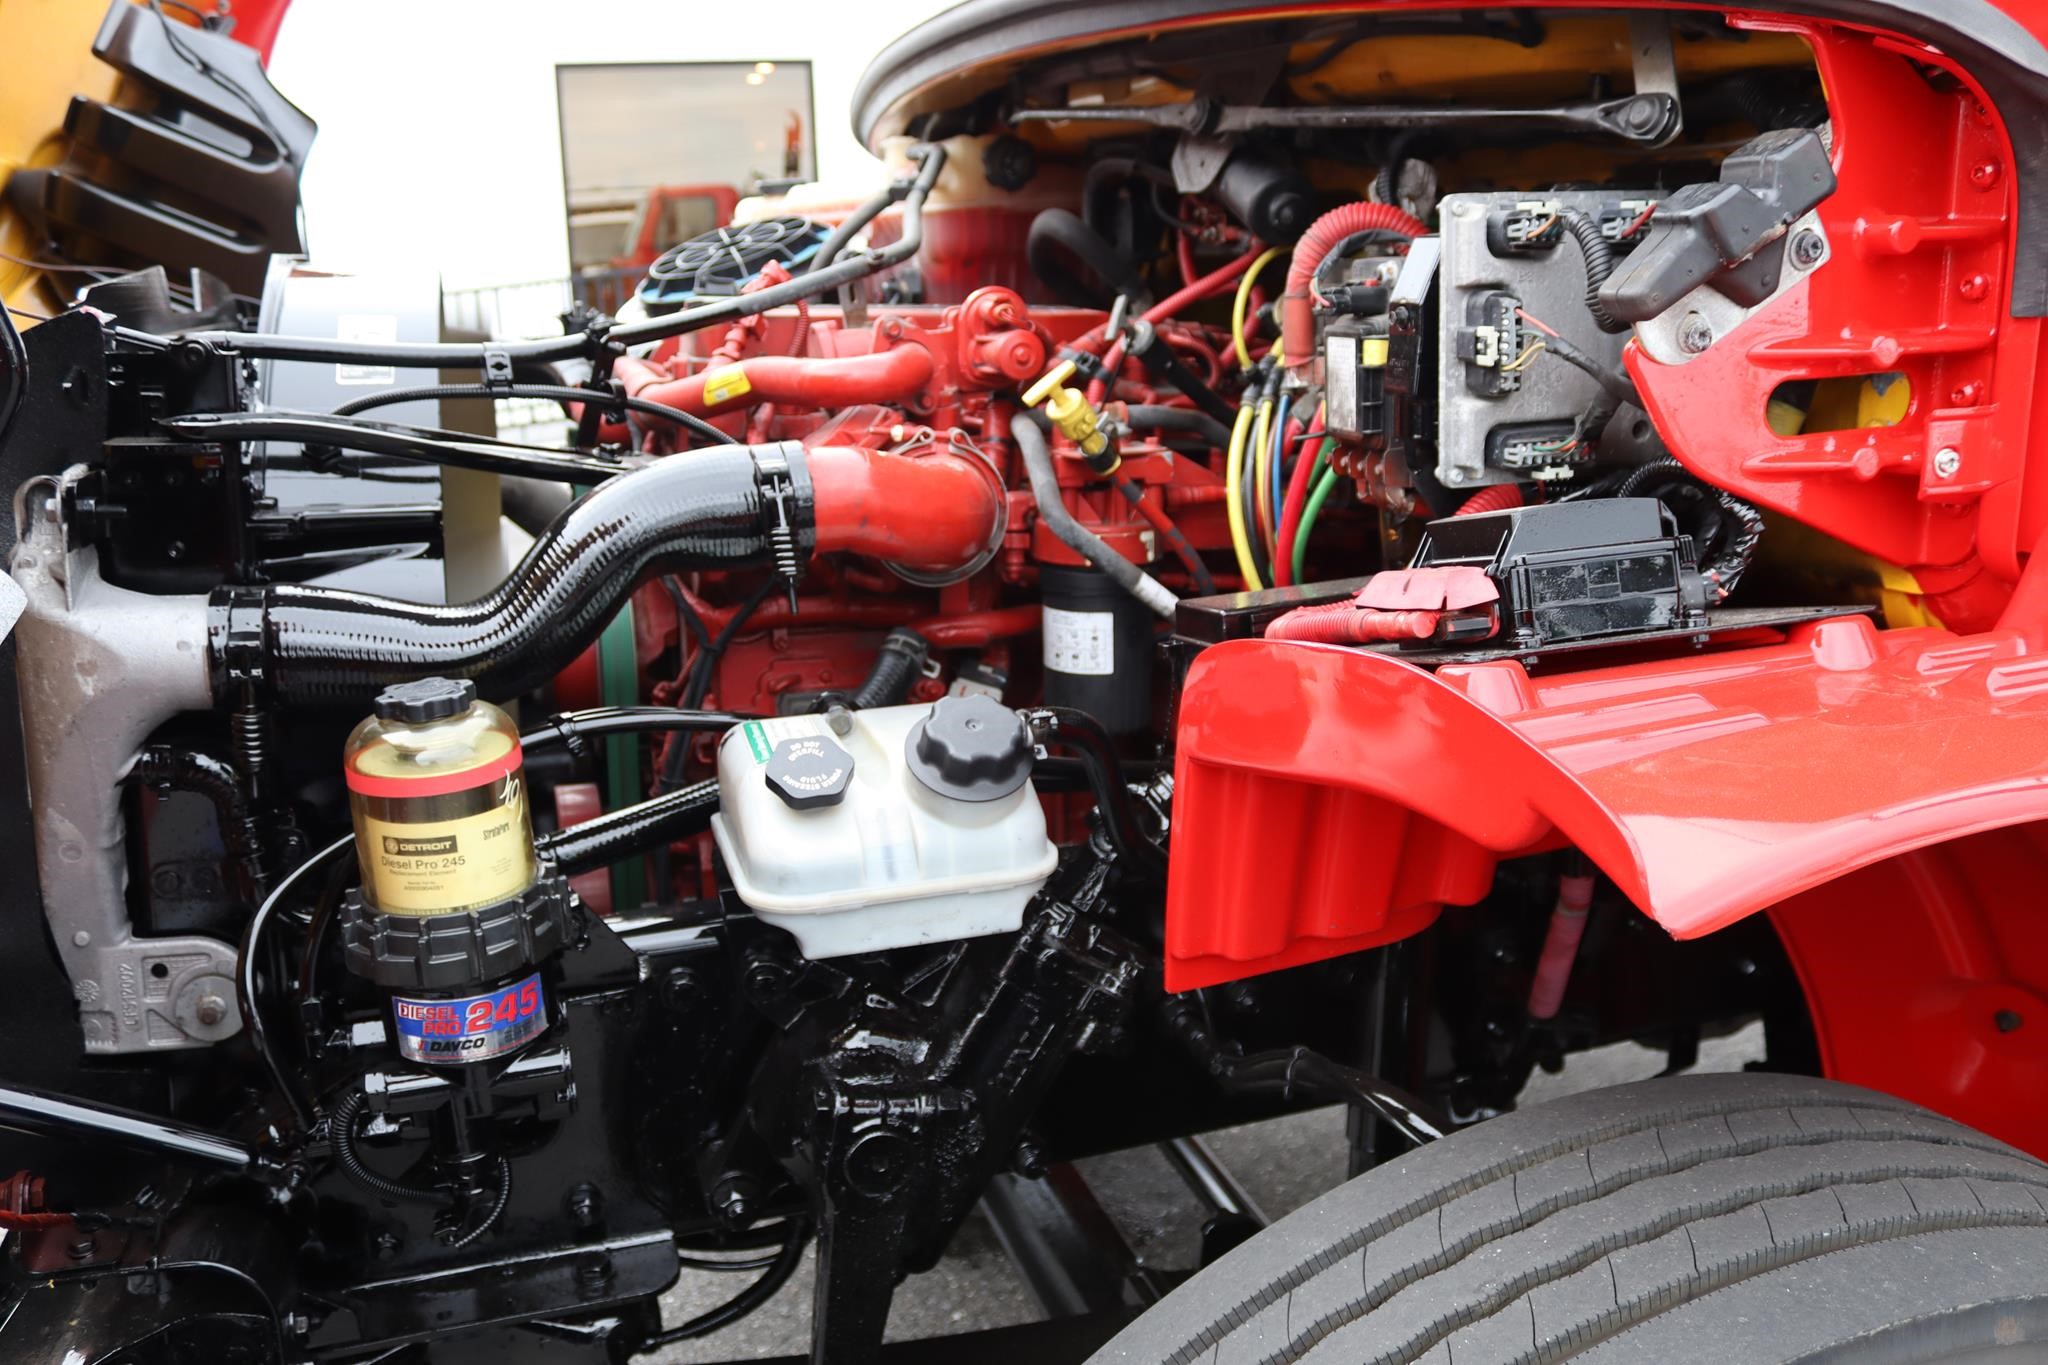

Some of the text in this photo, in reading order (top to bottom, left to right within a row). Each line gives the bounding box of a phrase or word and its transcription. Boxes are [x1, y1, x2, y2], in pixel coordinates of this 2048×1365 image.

[782, 775, 821, 790] STEERING
[800, 773, 828, 784] FLUID
[400, 841, 452, 852] DETROIT
[382, 855, 466, 870] Diesel Pro 245
[398, 1002, 460, 1021] DIESEL
[464, 981, 539, 1035] 245
[423, 1021, 461, 1035] PRO
[430, 1037, 486, 1051] DAVCO
